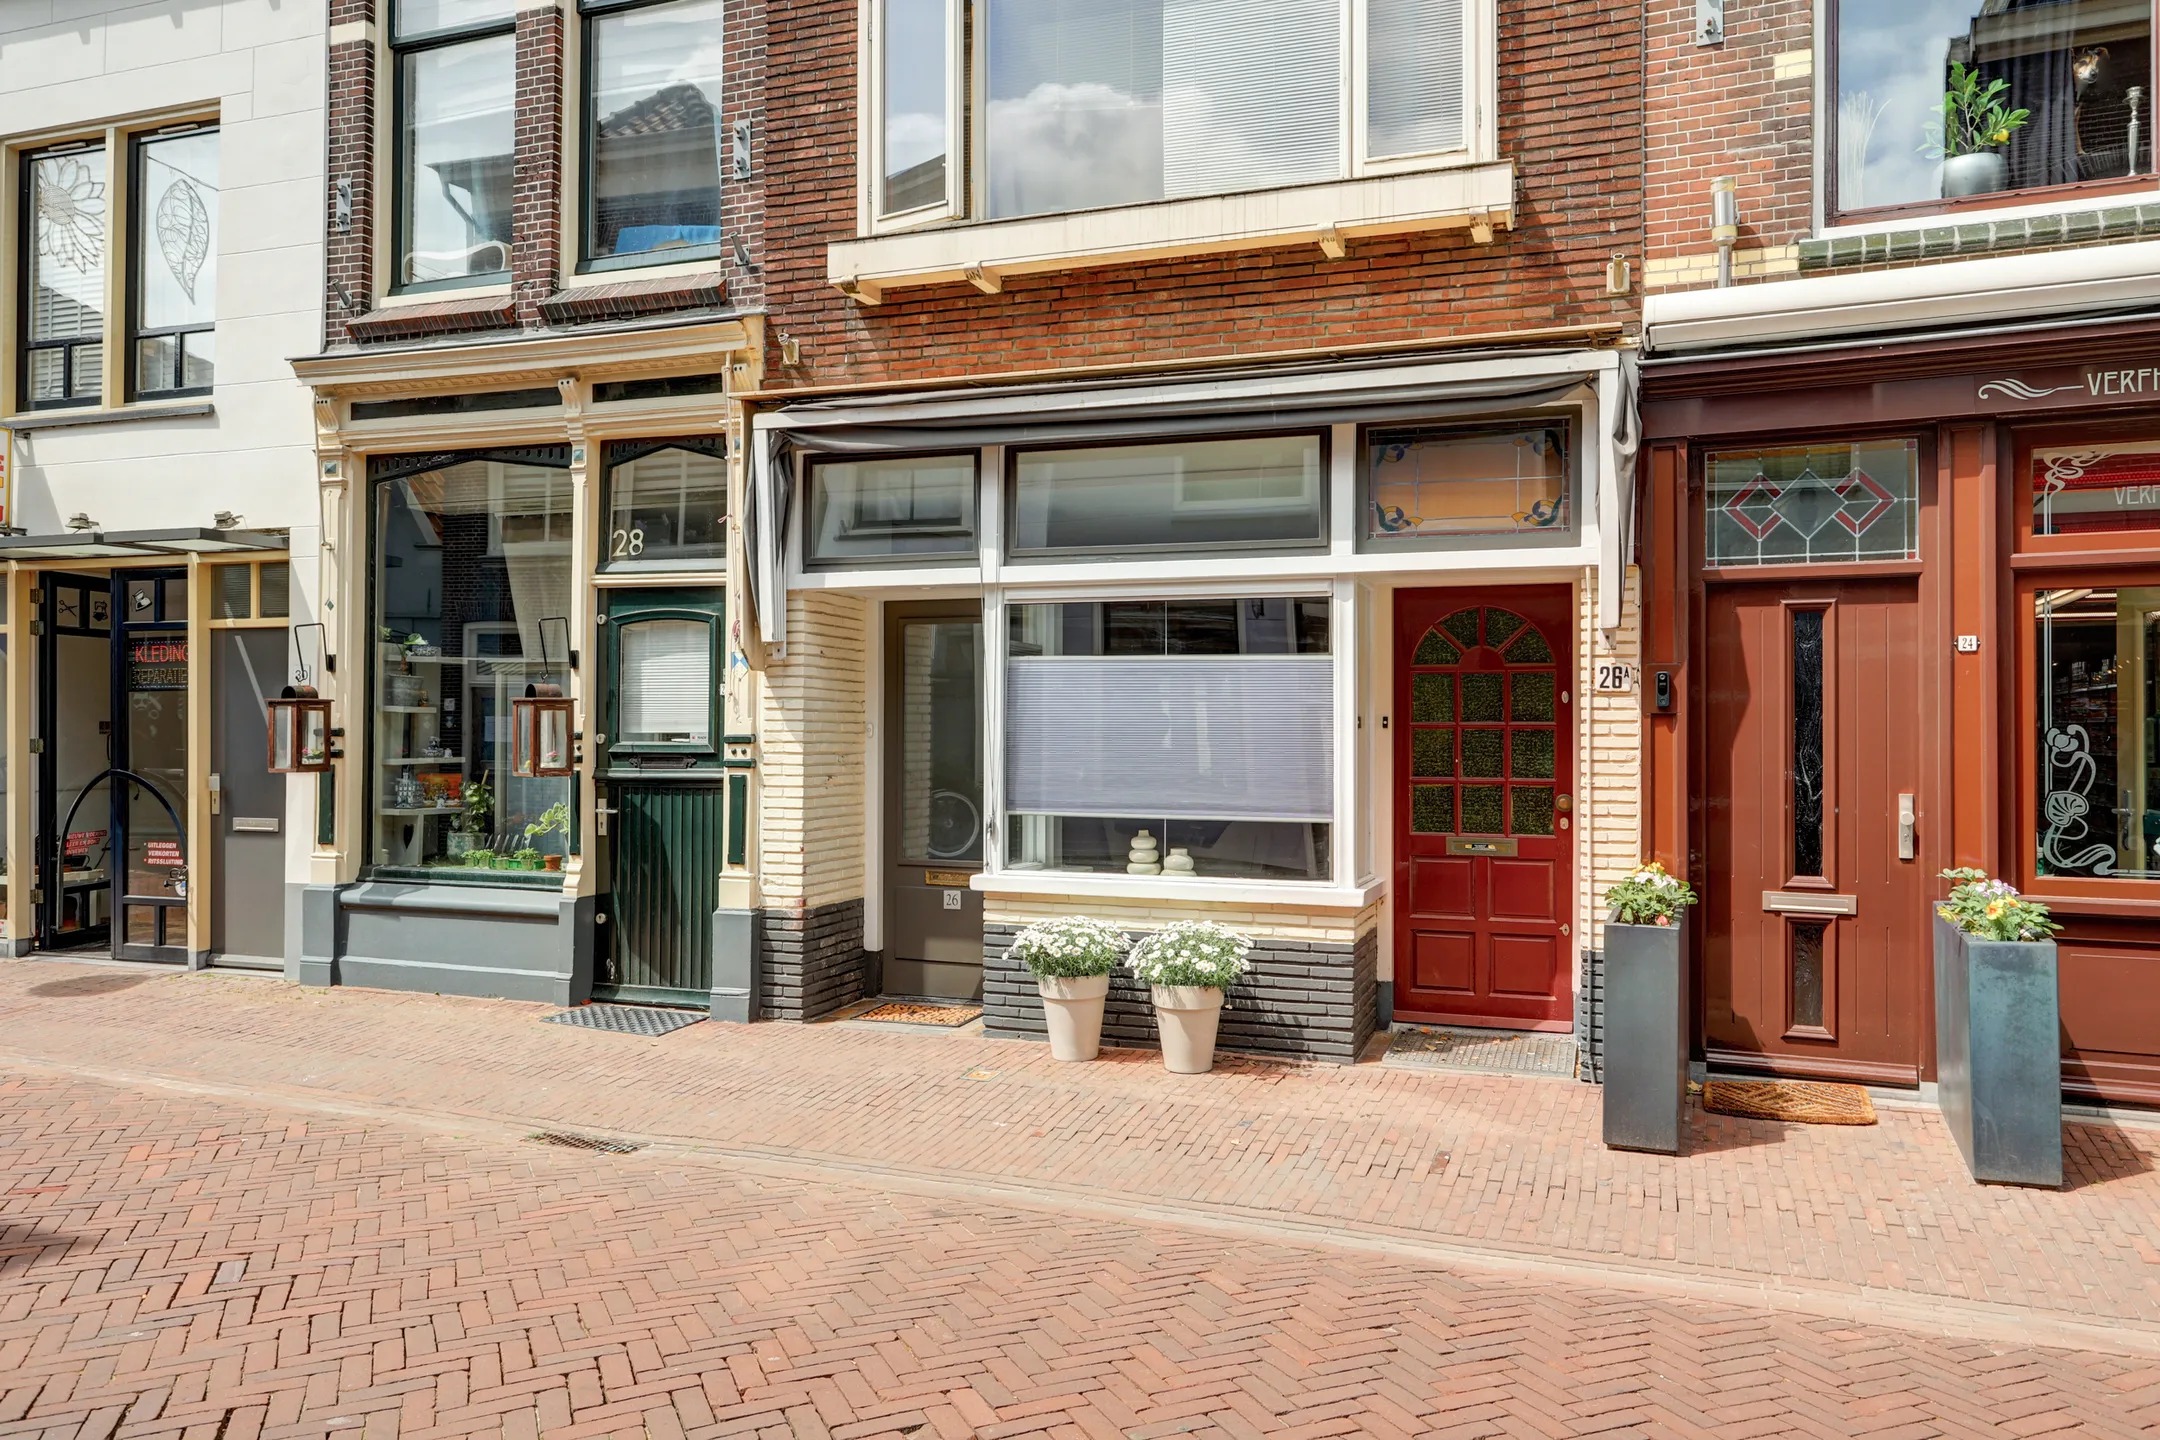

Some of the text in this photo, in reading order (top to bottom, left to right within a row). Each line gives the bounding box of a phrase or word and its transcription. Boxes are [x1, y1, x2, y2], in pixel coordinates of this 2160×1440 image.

[612, 529, 644, 557] 28
[1962, 637, 1973, 650] 24
[135, 645, 188, 662] KLEDING
[147, 858, 184, 866] RITSSLUITING
[946, 893, 959, 906] 26
